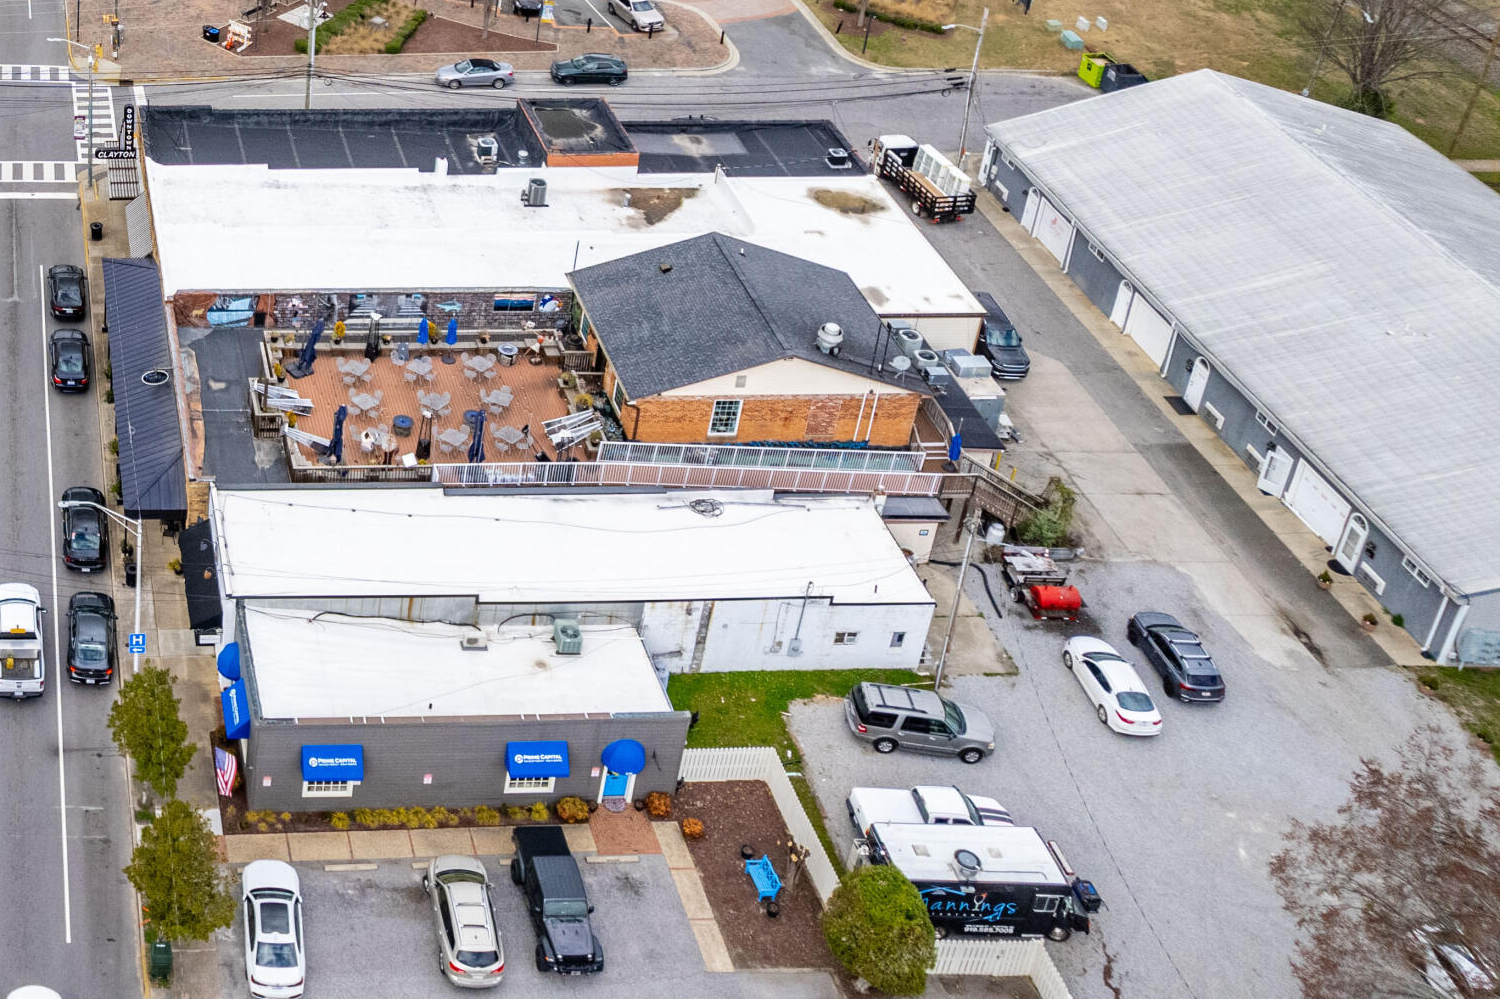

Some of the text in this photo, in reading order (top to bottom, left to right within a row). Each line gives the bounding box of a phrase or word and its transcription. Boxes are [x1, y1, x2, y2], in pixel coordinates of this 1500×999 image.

[126, 108, 134, 150] DOWNTOWN
[97, 150, 136, 159] CLAYTON
[132, 635, 143, 646] H
